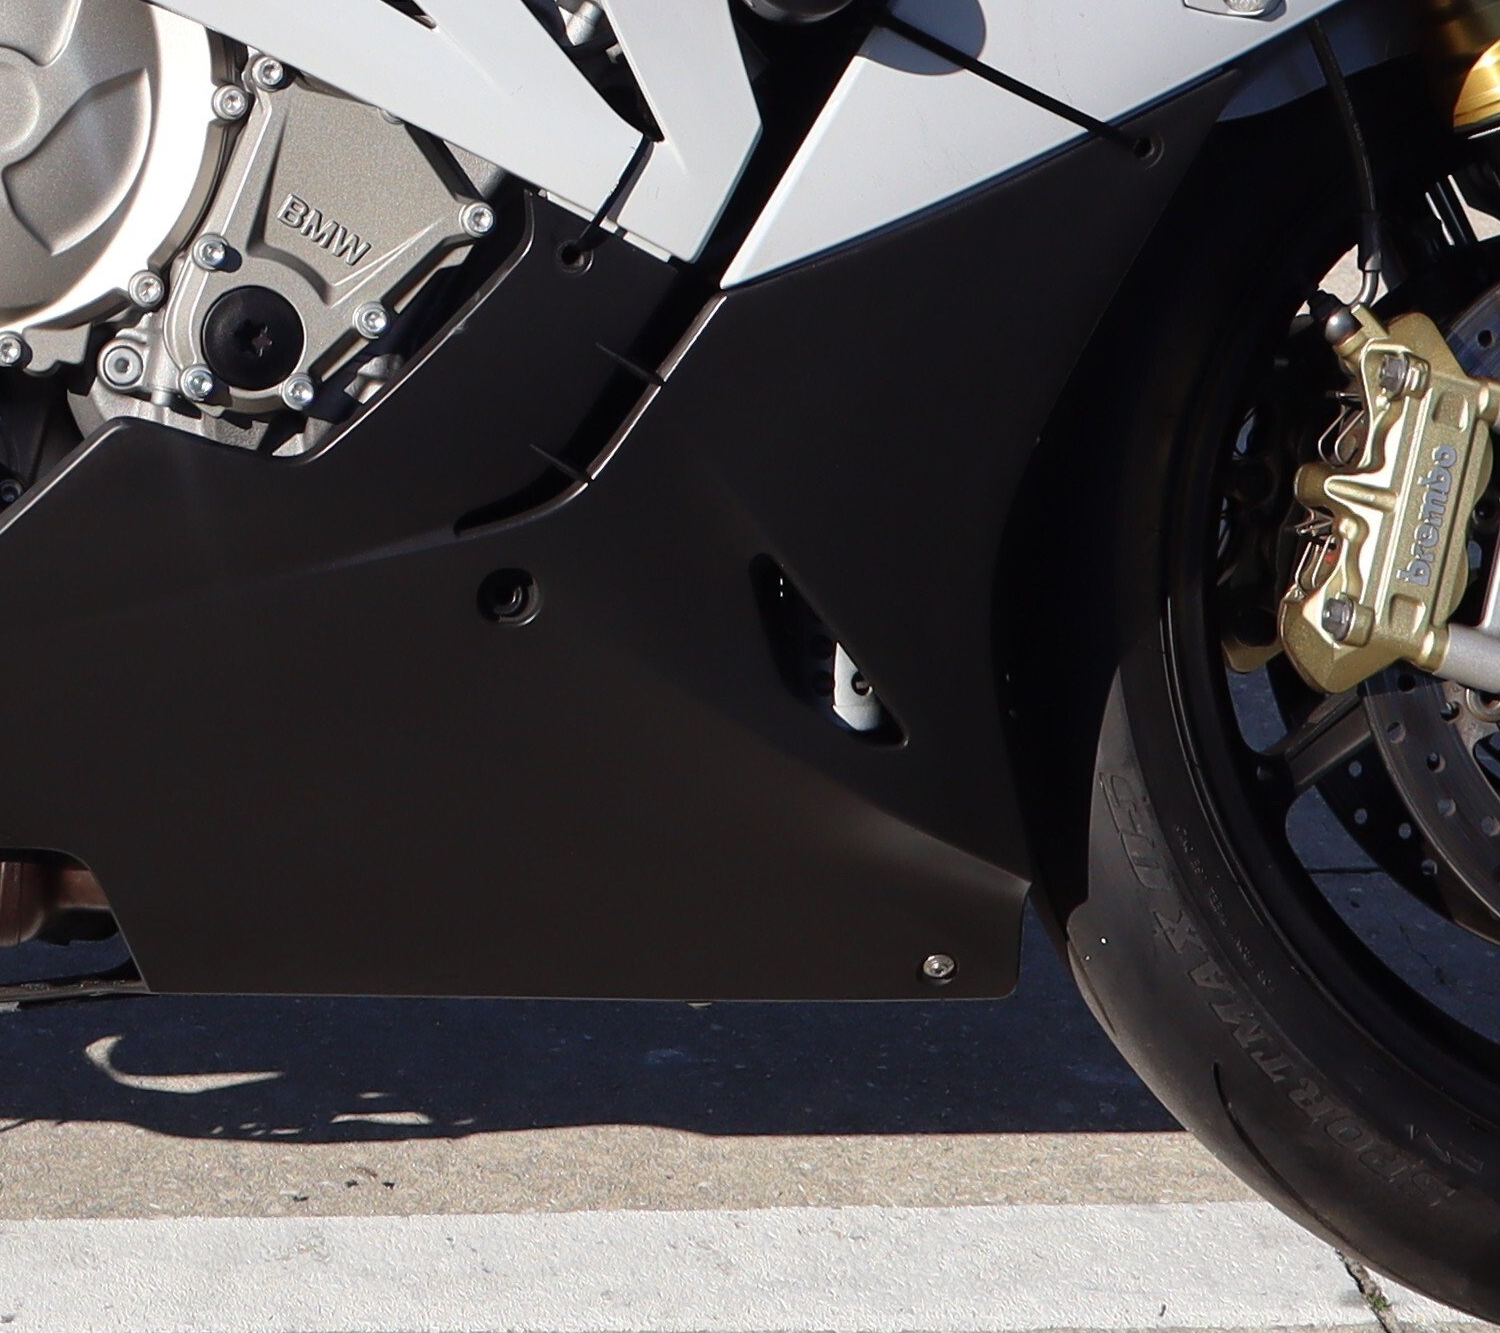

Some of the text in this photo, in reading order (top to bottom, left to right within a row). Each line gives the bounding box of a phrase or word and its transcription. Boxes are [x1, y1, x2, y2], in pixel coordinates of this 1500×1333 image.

[277, 193, 372, 267] BMW
[1396, 444, 1457, 587] brembo
[1152, 900, 1457, 1213] SPORTMAX
